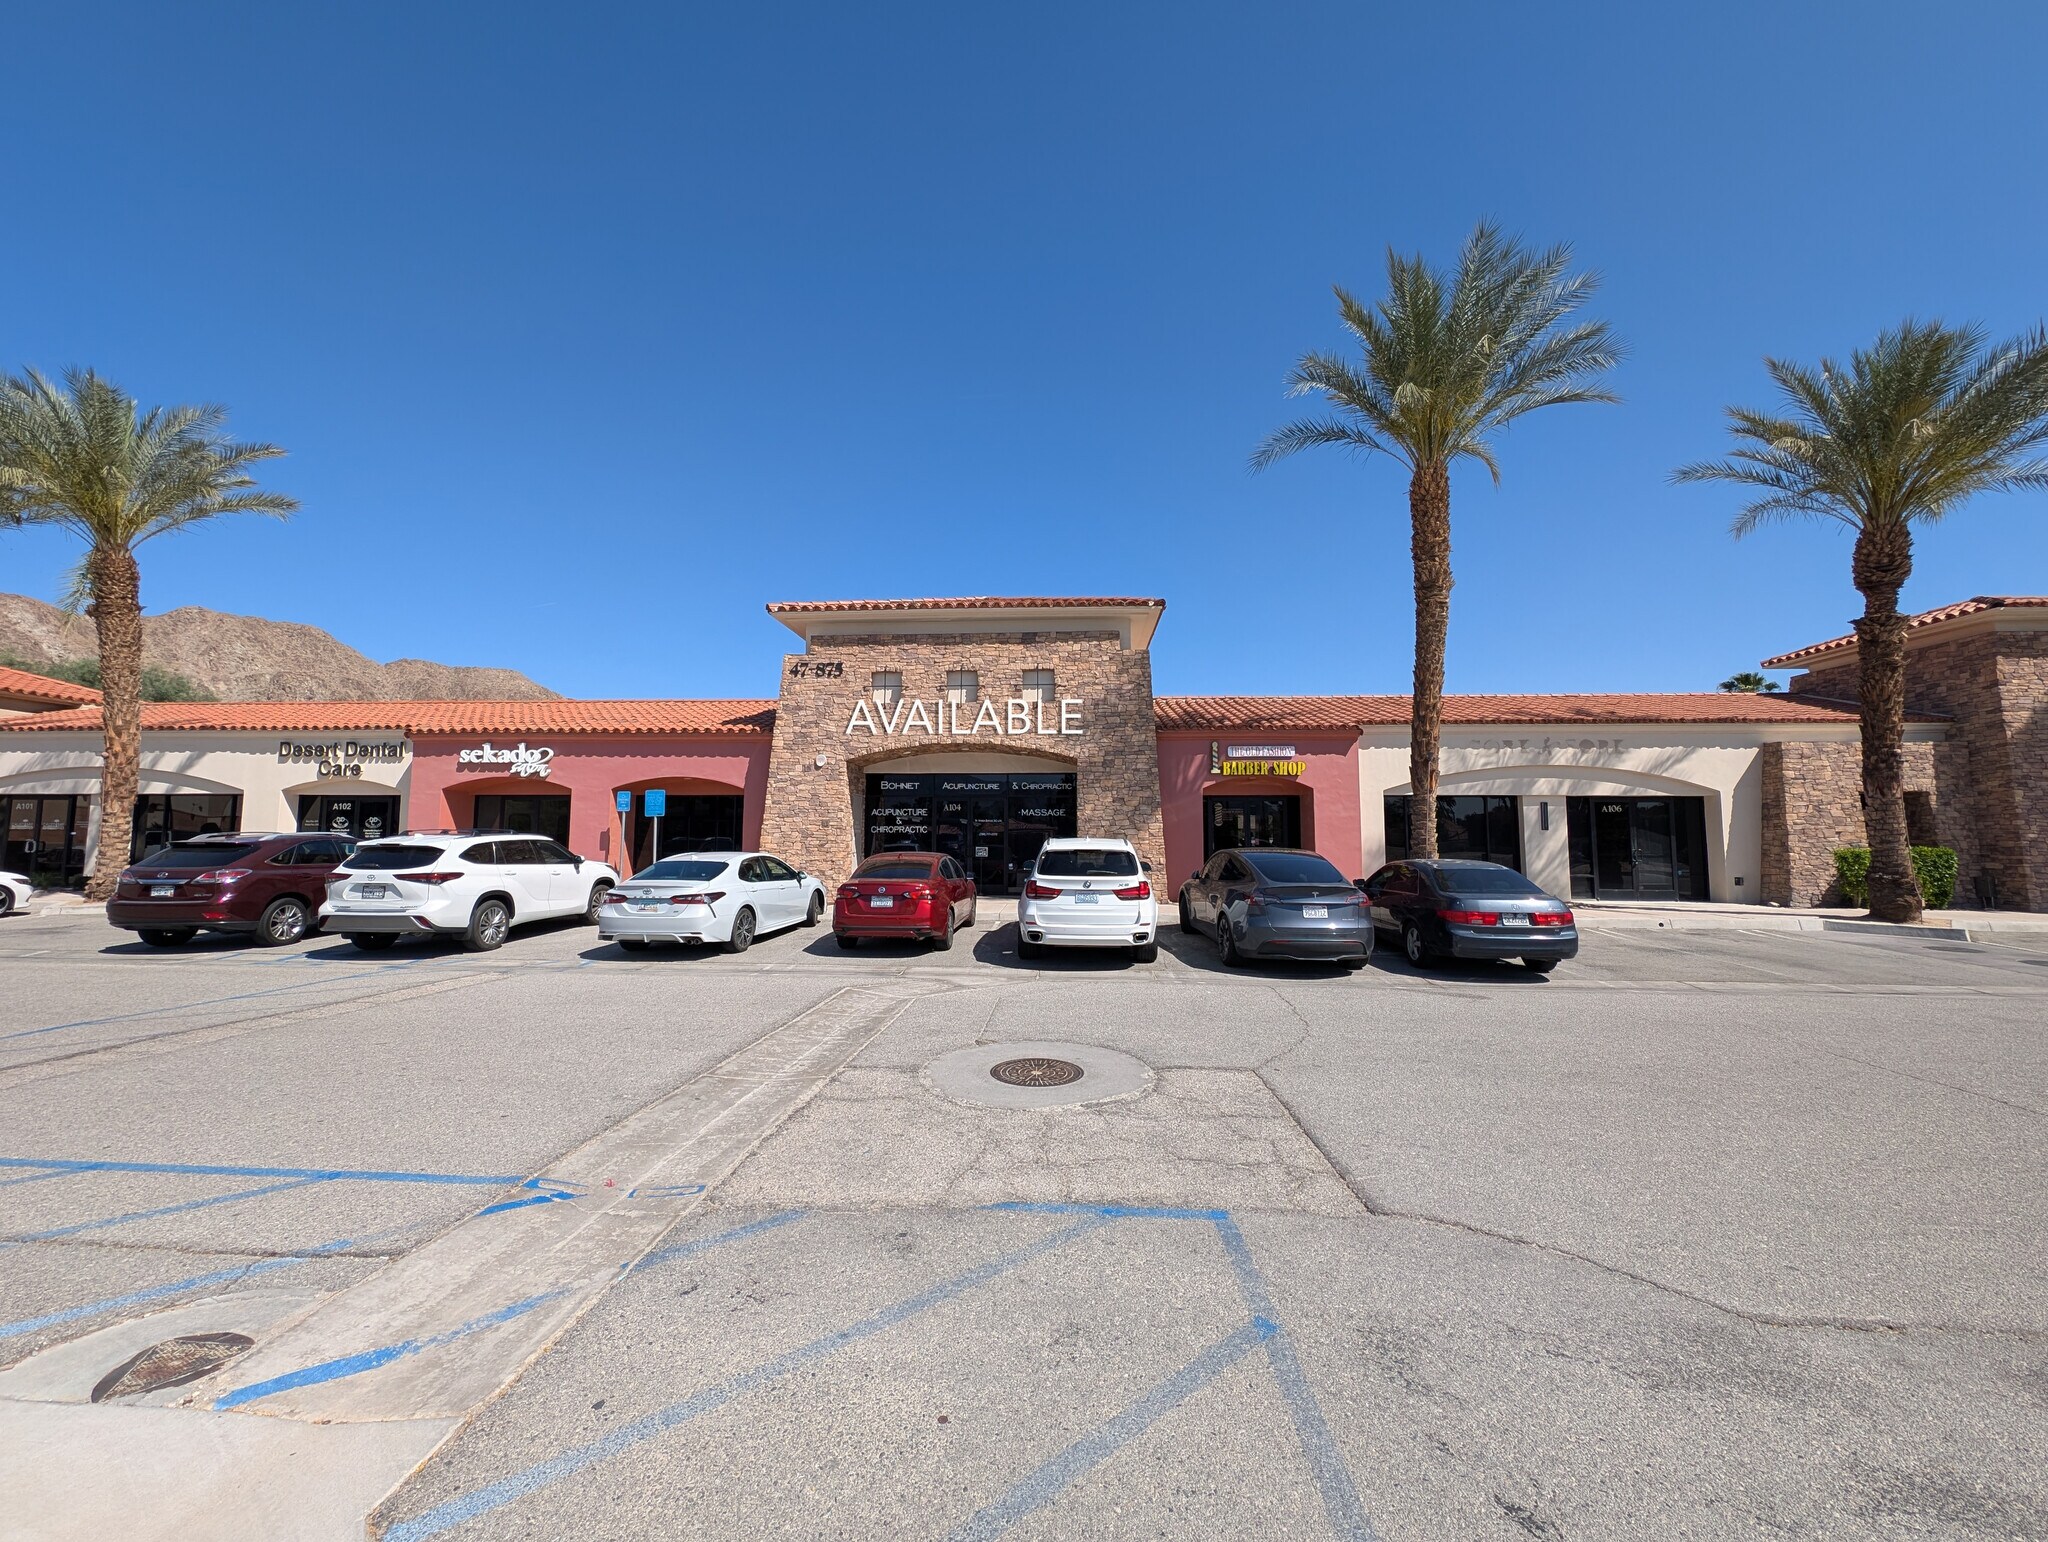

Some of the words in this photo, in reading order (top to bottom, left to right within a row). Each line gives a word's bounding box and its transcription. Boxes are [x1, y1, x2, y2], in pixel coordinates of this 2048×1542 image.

[845, 698, 1084, 735] AVAILABLE
[279, 741, 339, 758] Desert
[345, 741, 405, 758] Dental
[459, 742, 554, 763] sekado
[319, 759, 362, 777] Care
[1222, 761, 1269, 776] BARBER
[1273, 761, 1307, 776] SHOP
[880, 780, 920, 790] BOHNET
[941, 781, 1000, 790] ACUPUNCTURE
[1011, 781, 1019, 790] &
[1021, 781, 1073, 790] CHIROPRACTIC
[332, 802, 352, 811] A102
[943, 803, 962, 812] A104
[1601, 804, 1623, 813] A106
[871, 808, 928, 817] ACUPUNCTURE
[1020, 808, 1067, 817] MASSAGE
[870, 825, 928, 834] CHIROPRACTIC
